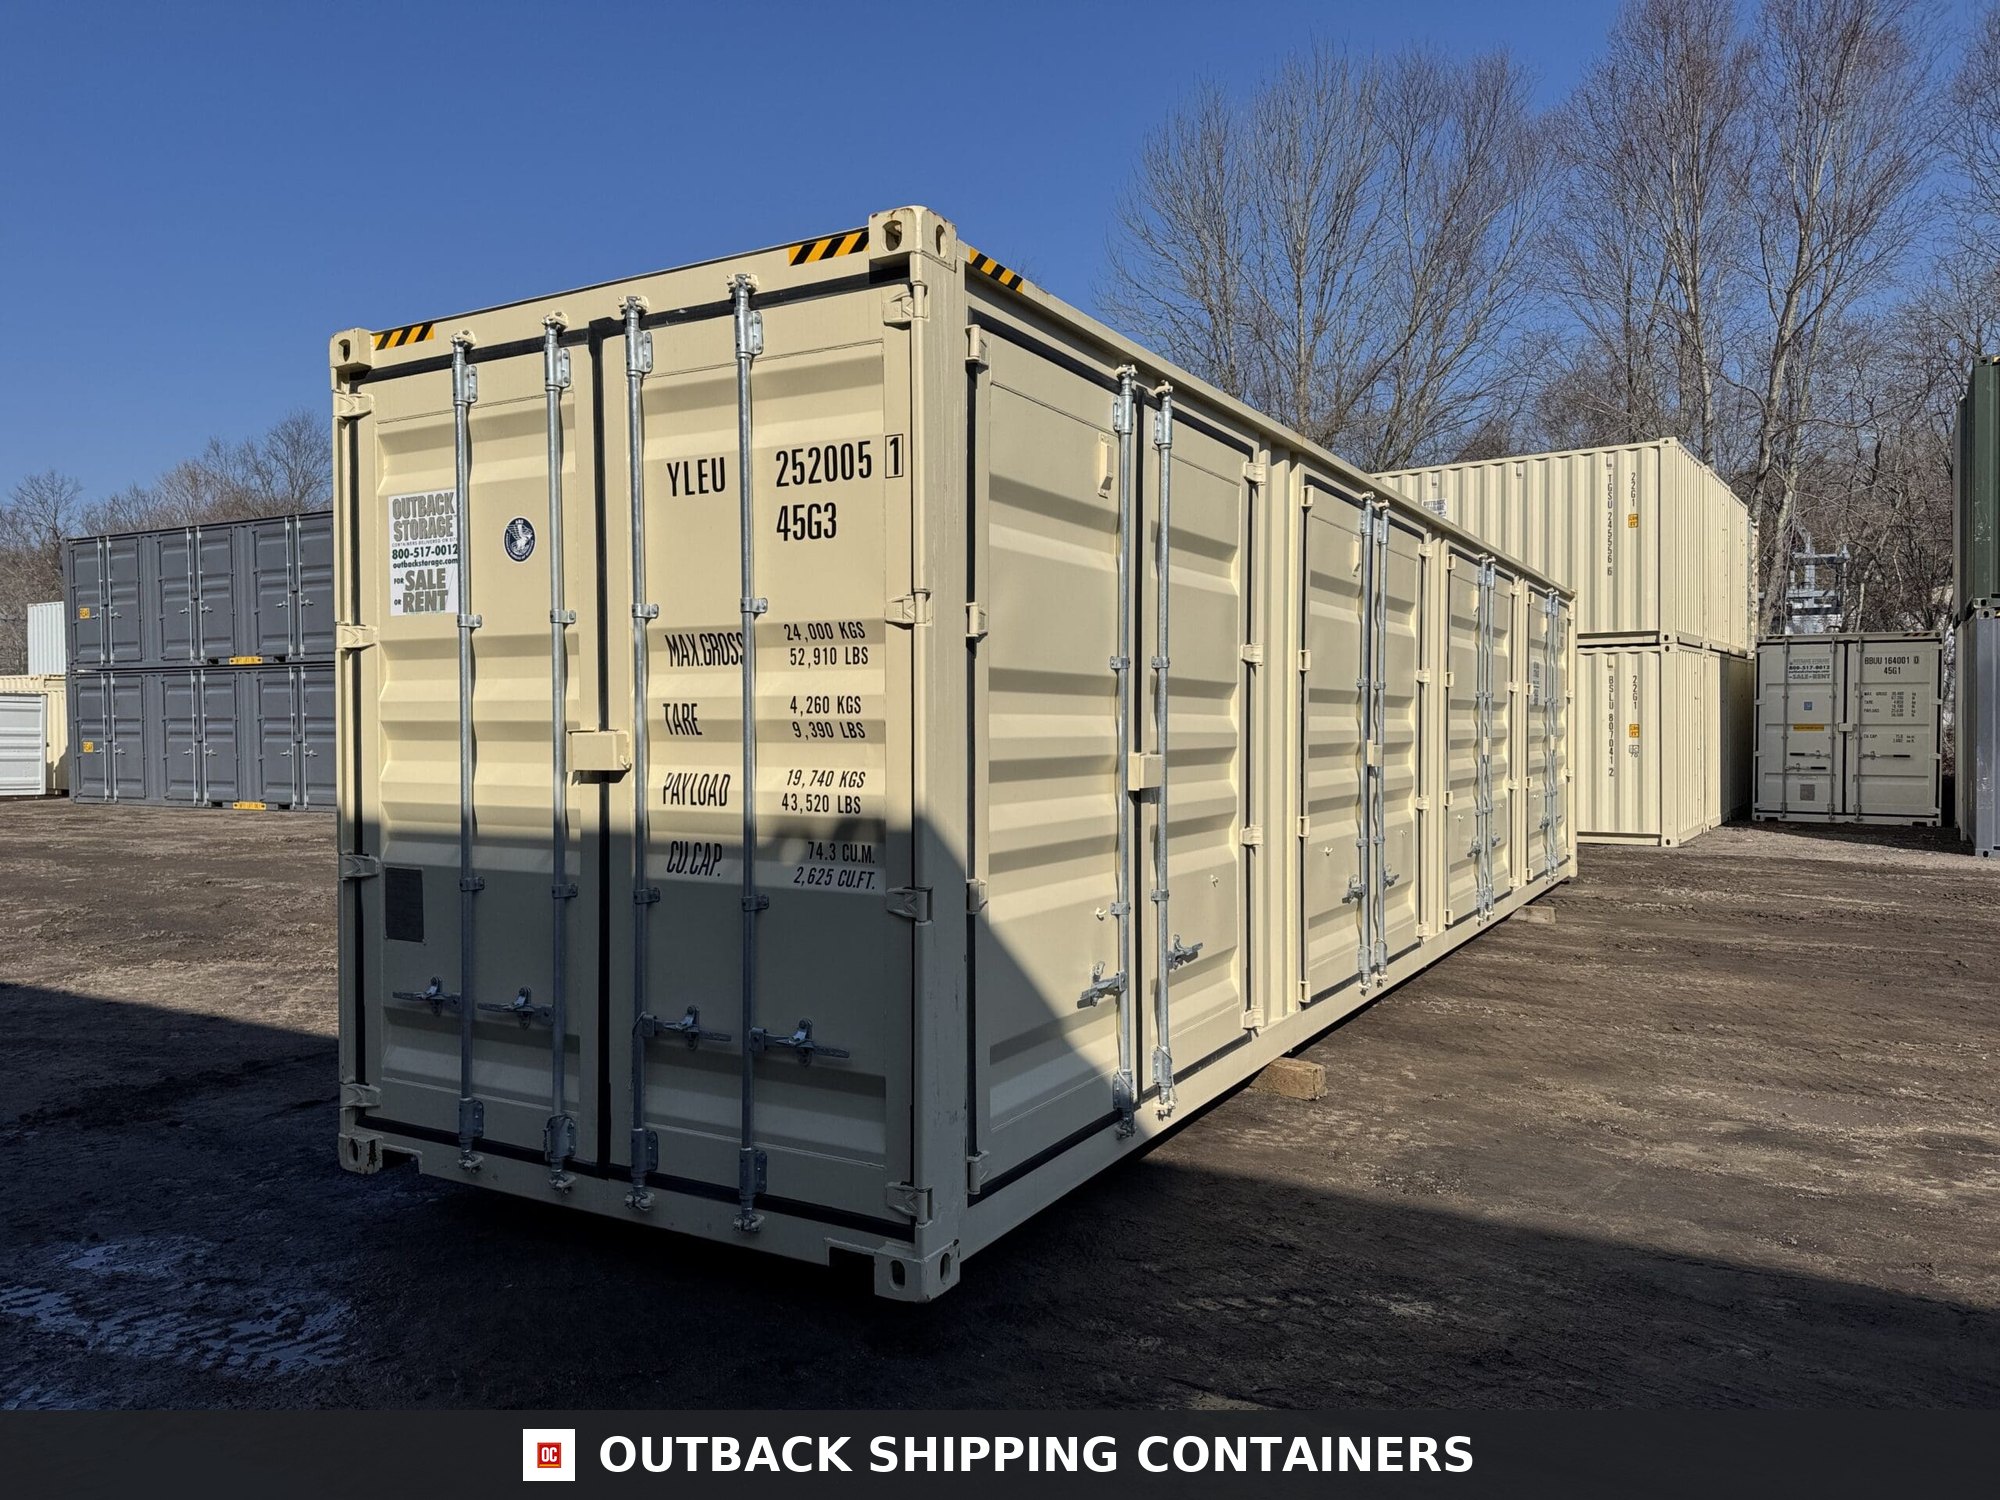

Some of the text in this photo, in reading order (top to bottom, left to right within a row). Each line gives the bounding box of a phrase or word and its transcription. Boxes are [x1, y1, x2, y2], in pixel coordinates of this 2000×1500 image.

[666, 437, 900, 497] YLEU 252005 1
[392, 492, 455, 520] OUTBACK
[393, 515, 454, 542] STORAGE
[776, 502, 837, 541] 45G3
[392, 543, 458, 560] 800-517-0012
[392, 558, 460, 569] outbackstorage.com
[1607, 567, 1613, 576] 6
[405, 568, 446, 592] SALE
[403, 589, 448, 613] RENT
[784, 623, 834, 643] 24,000
[838, 621, 866, 639] KGS
[790, 646, 869, 668] 52,910 LBS
[1884, 656, 1910, 665] 164001
[1883, 666, 1901, 675] 45G1
[663, 695, 861, 735] TARE 4,260 KGS
[792, 721, 866, 741] 9,390 LBS
[1608, 768, 1614, 777] 2
[663, 770, 866, 807] PAYLOAD 19,740 KGS
[782, 793, 861, 814] 43,520 LBS
[666, 840, 876, 877] CU.CAP. 74.3 CU.M.
[793, 866, 876, 890] 2,625 CU.FT.
